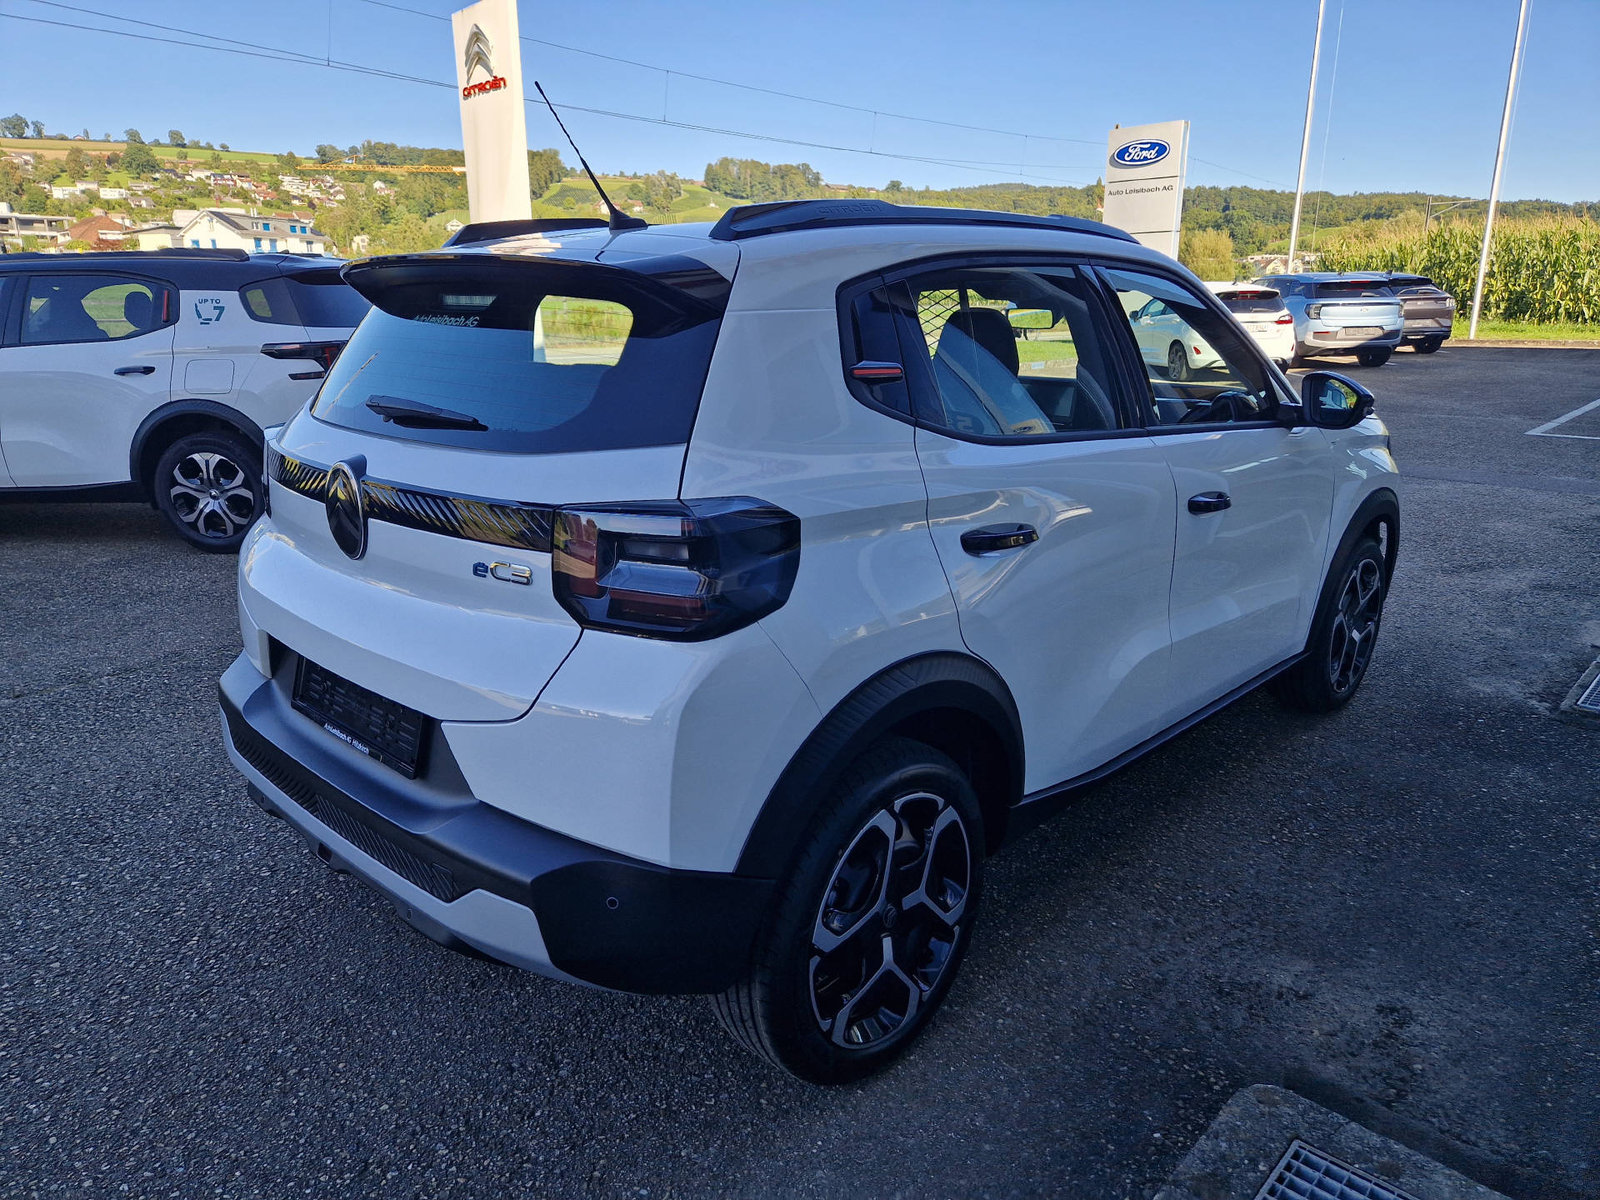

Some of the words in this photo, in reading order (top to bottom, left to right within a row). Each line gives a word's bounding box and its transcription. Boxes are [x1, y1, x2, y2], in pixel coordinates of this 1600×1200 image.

[1124, 143, 1159, 161] Ford
[1125, 186, 1160, 195] Leisibach
[1161, 184, 1174, 192] AG
[213, 305, 225, 322] 7
